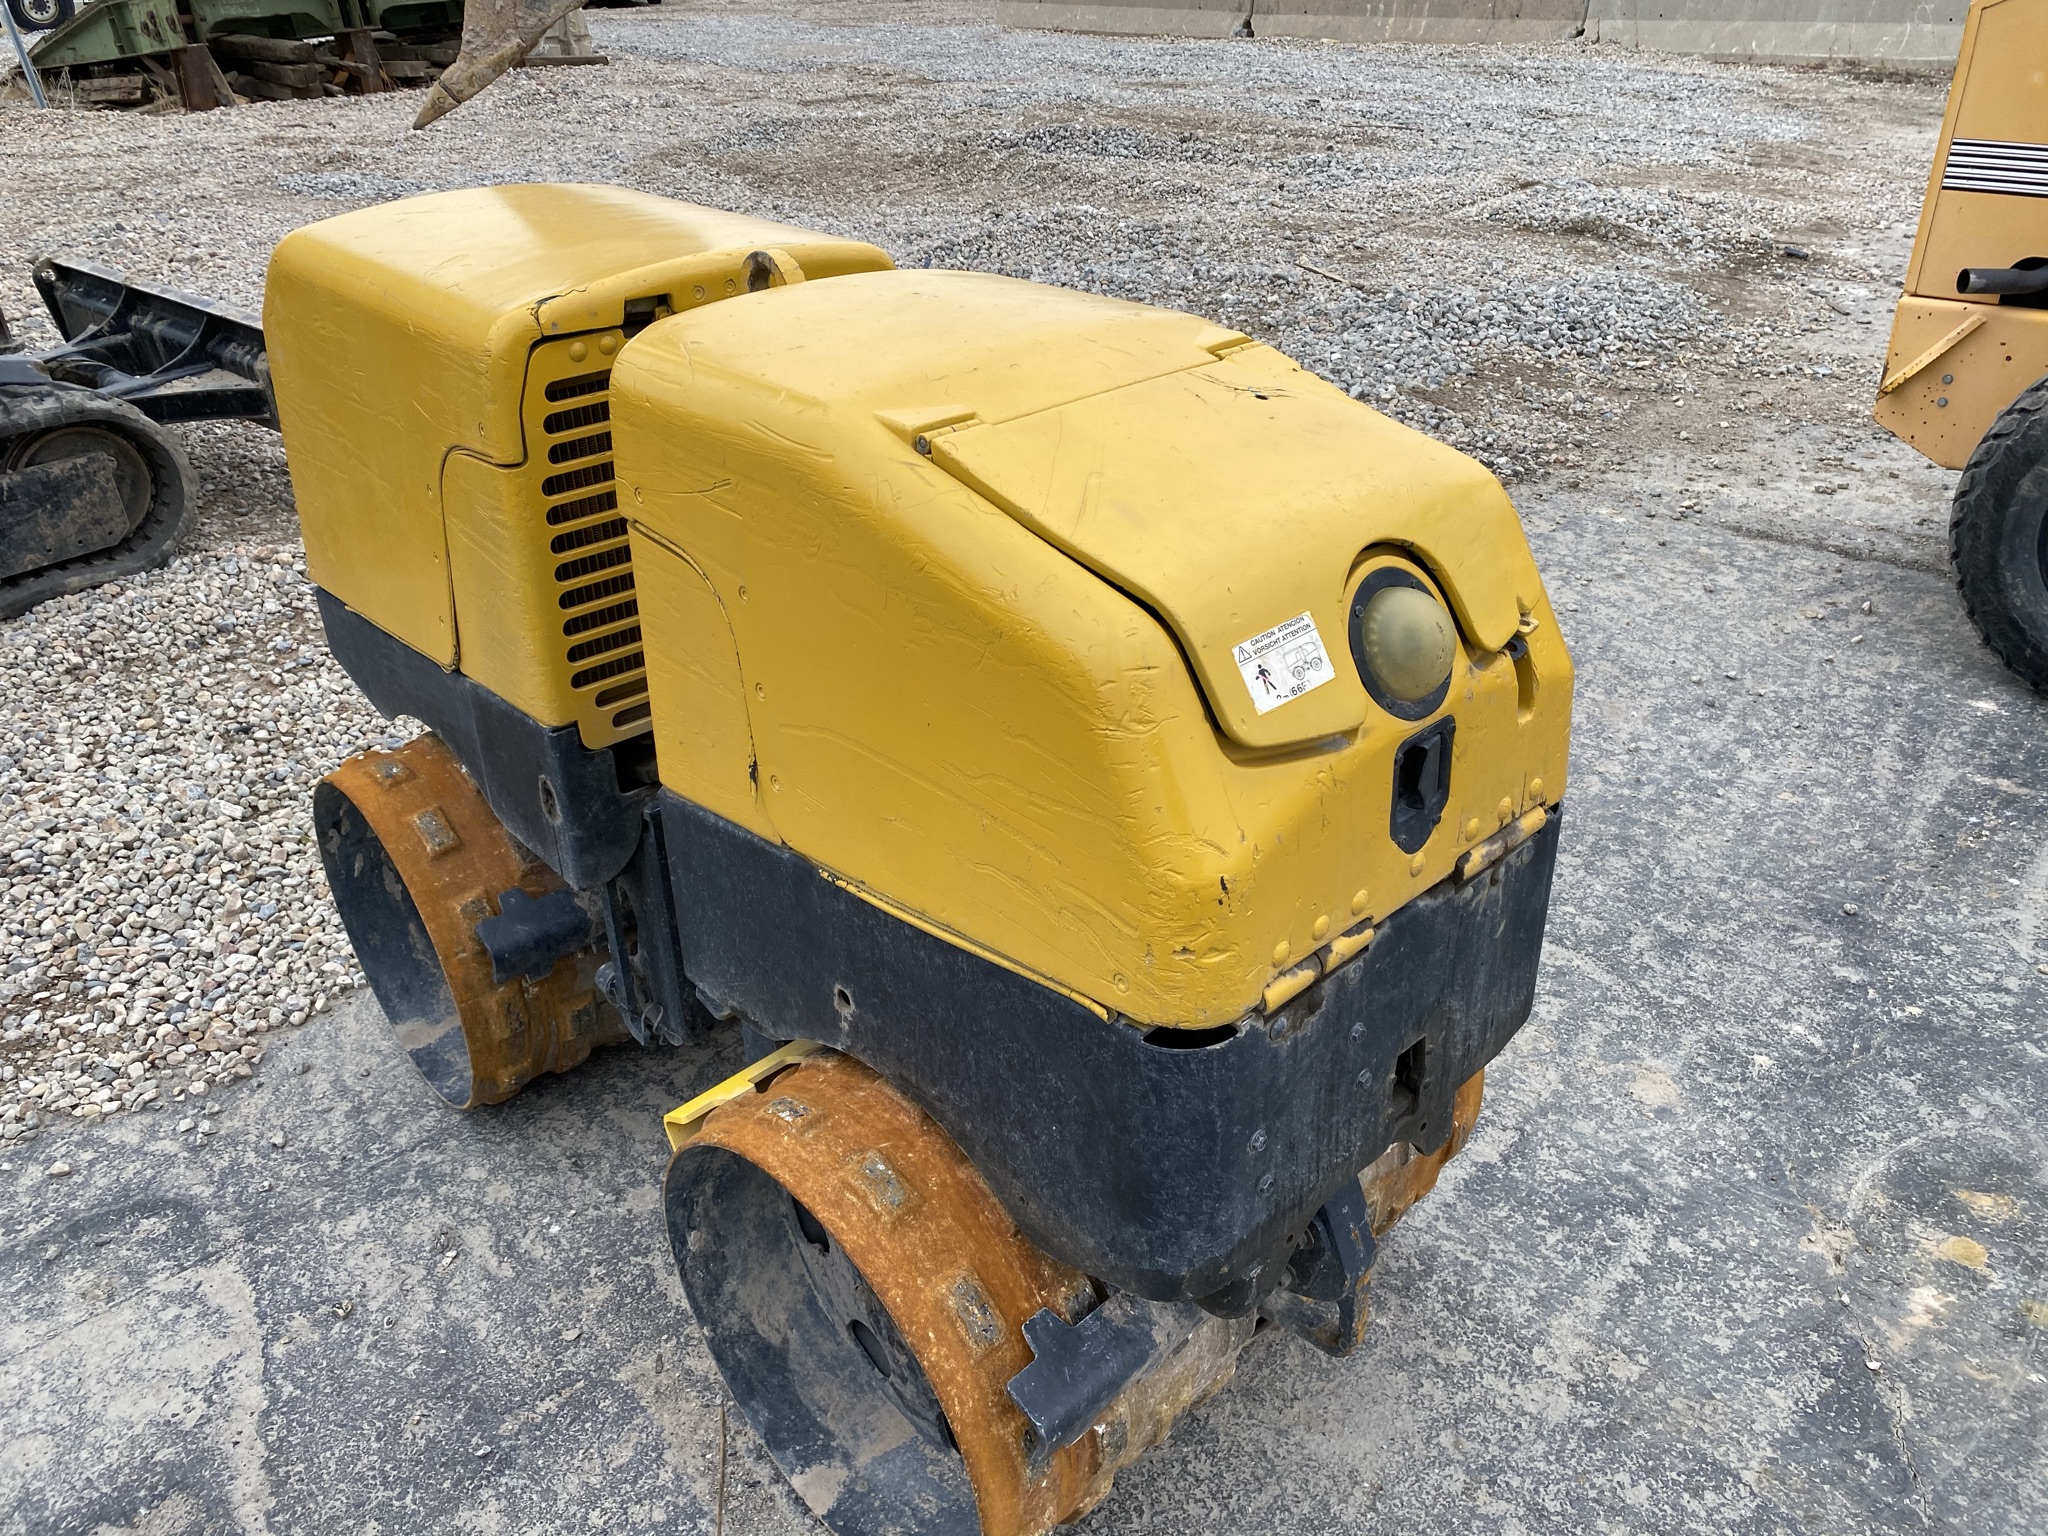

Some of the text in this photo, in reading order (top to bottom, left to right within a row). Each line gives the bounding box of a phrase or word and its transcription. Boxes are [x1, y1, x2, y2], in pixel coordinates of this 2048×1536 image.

[1250, 616, 1305, 647] CAUTION ATENCION
[1252, 622, 1312, 656] VORSICHT ATTENTION
